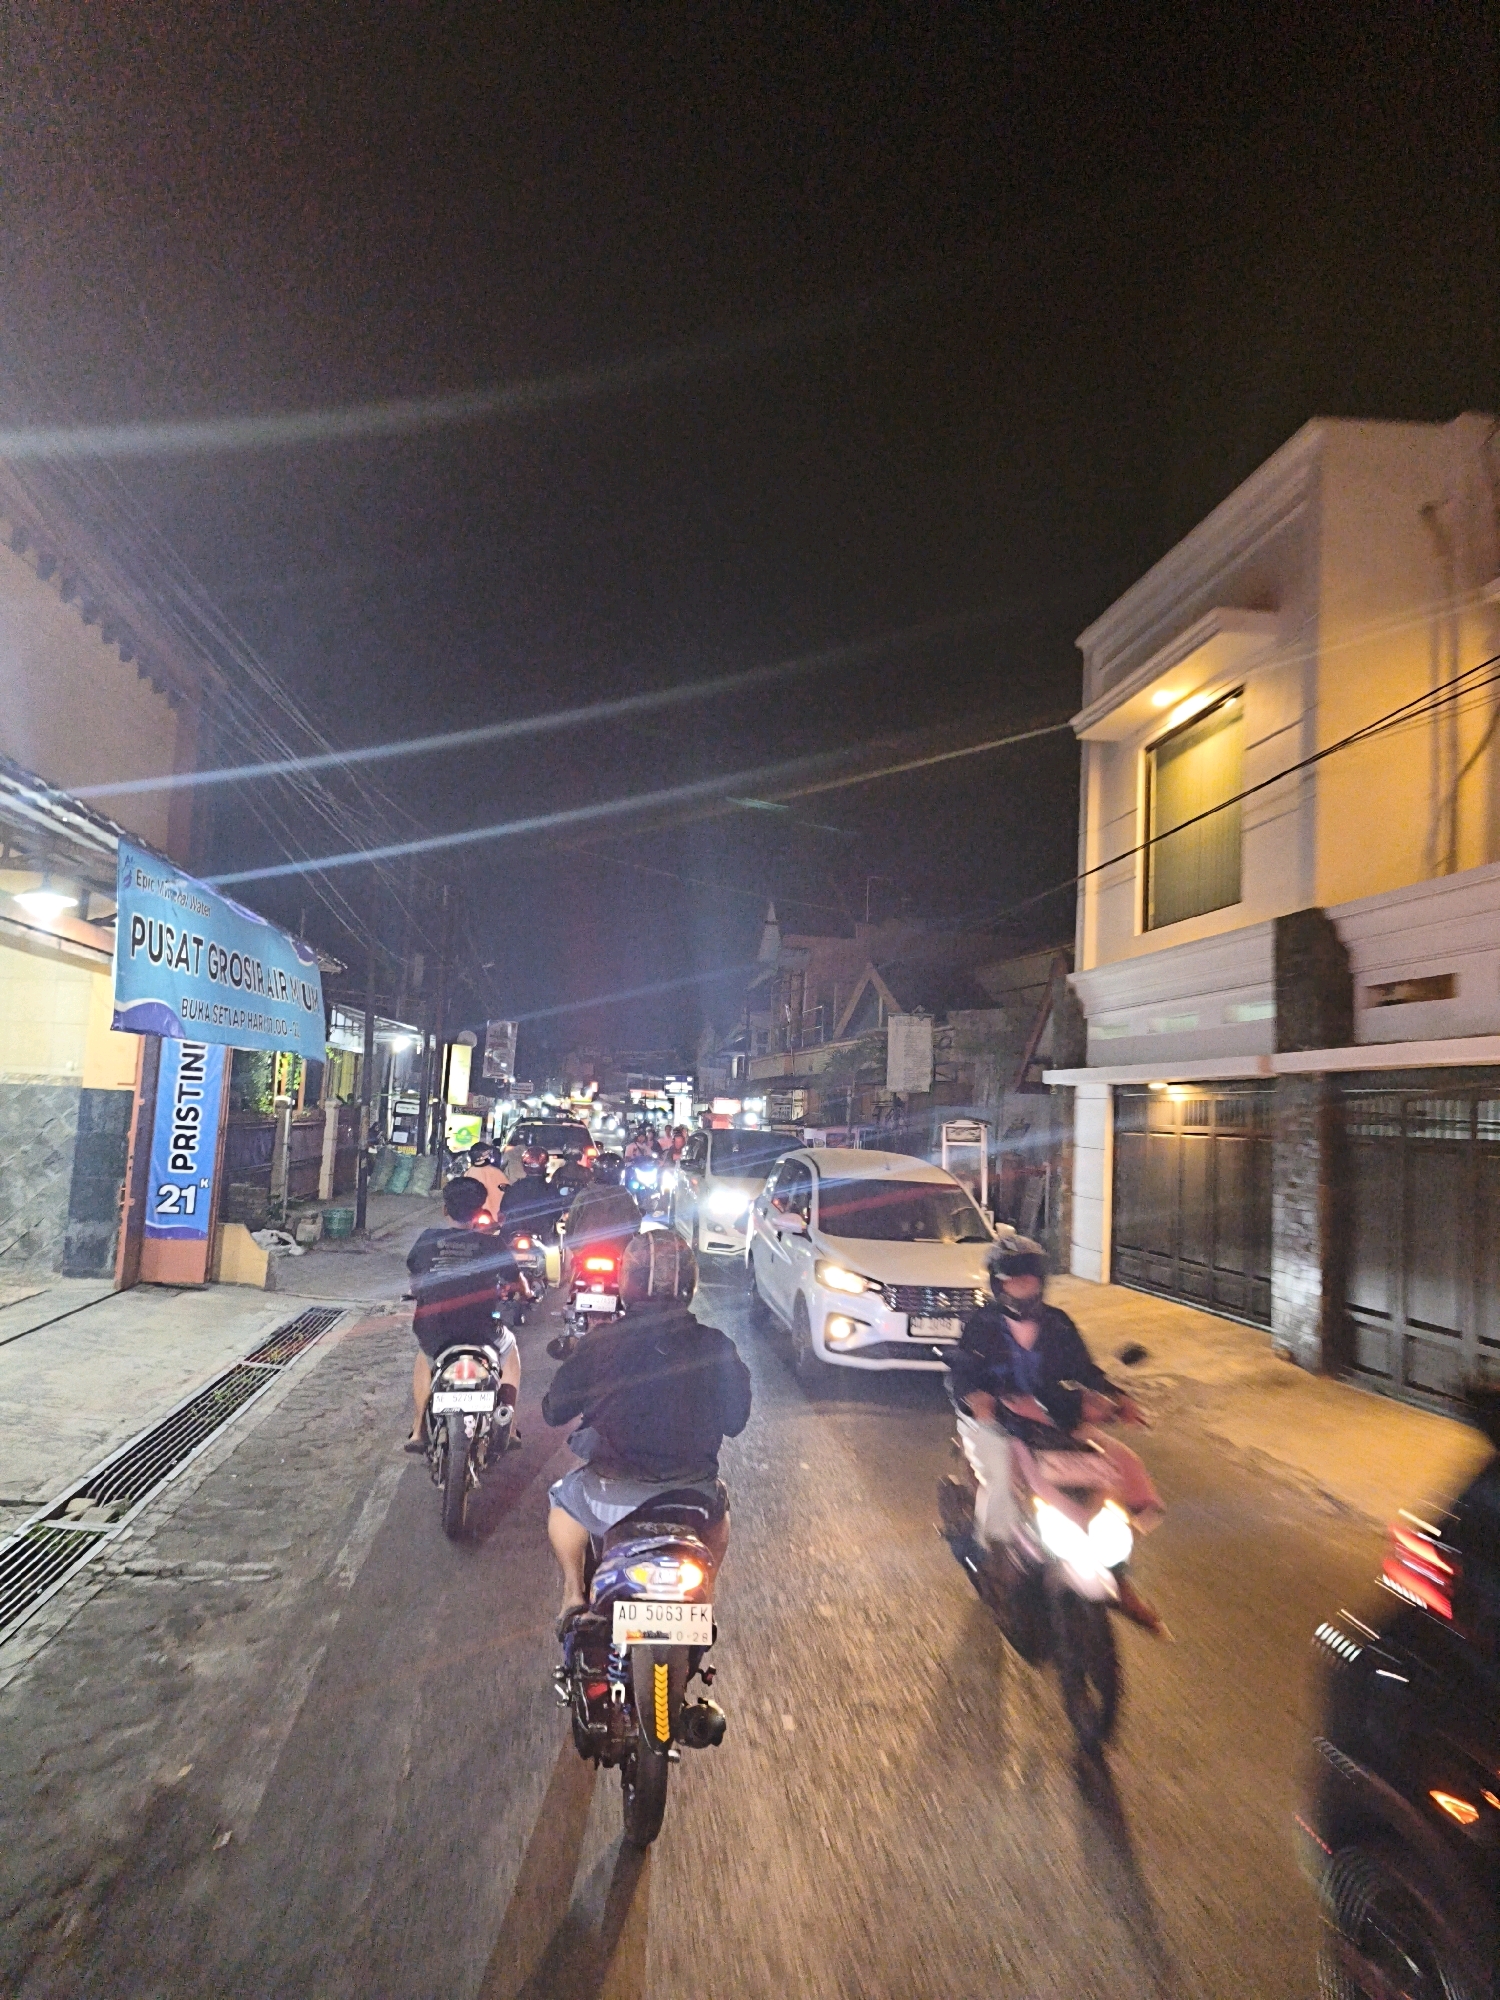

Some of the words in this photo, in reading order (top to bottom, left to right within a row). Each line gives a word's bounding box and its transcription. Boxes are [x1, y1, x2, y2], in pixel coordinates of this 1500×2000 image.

[136, 869, 155, 892] Epic
[190, 895, 211, 917] Water
[130, 914, 204, 975] PUSAT
[207, 943, 265, 995] GROSIR
[267, 967, 288, 1001] AIR
[181, 998, 210, 1022] BUKA
[213, 1004, 245, 1028] SETIAP
[247, 1012, 265, 1032] HARI
[618, 1604, 637, 1620] AD
[646, 1604, 683, 1622] 5063
[690, 1606, 709, 1622] FK
